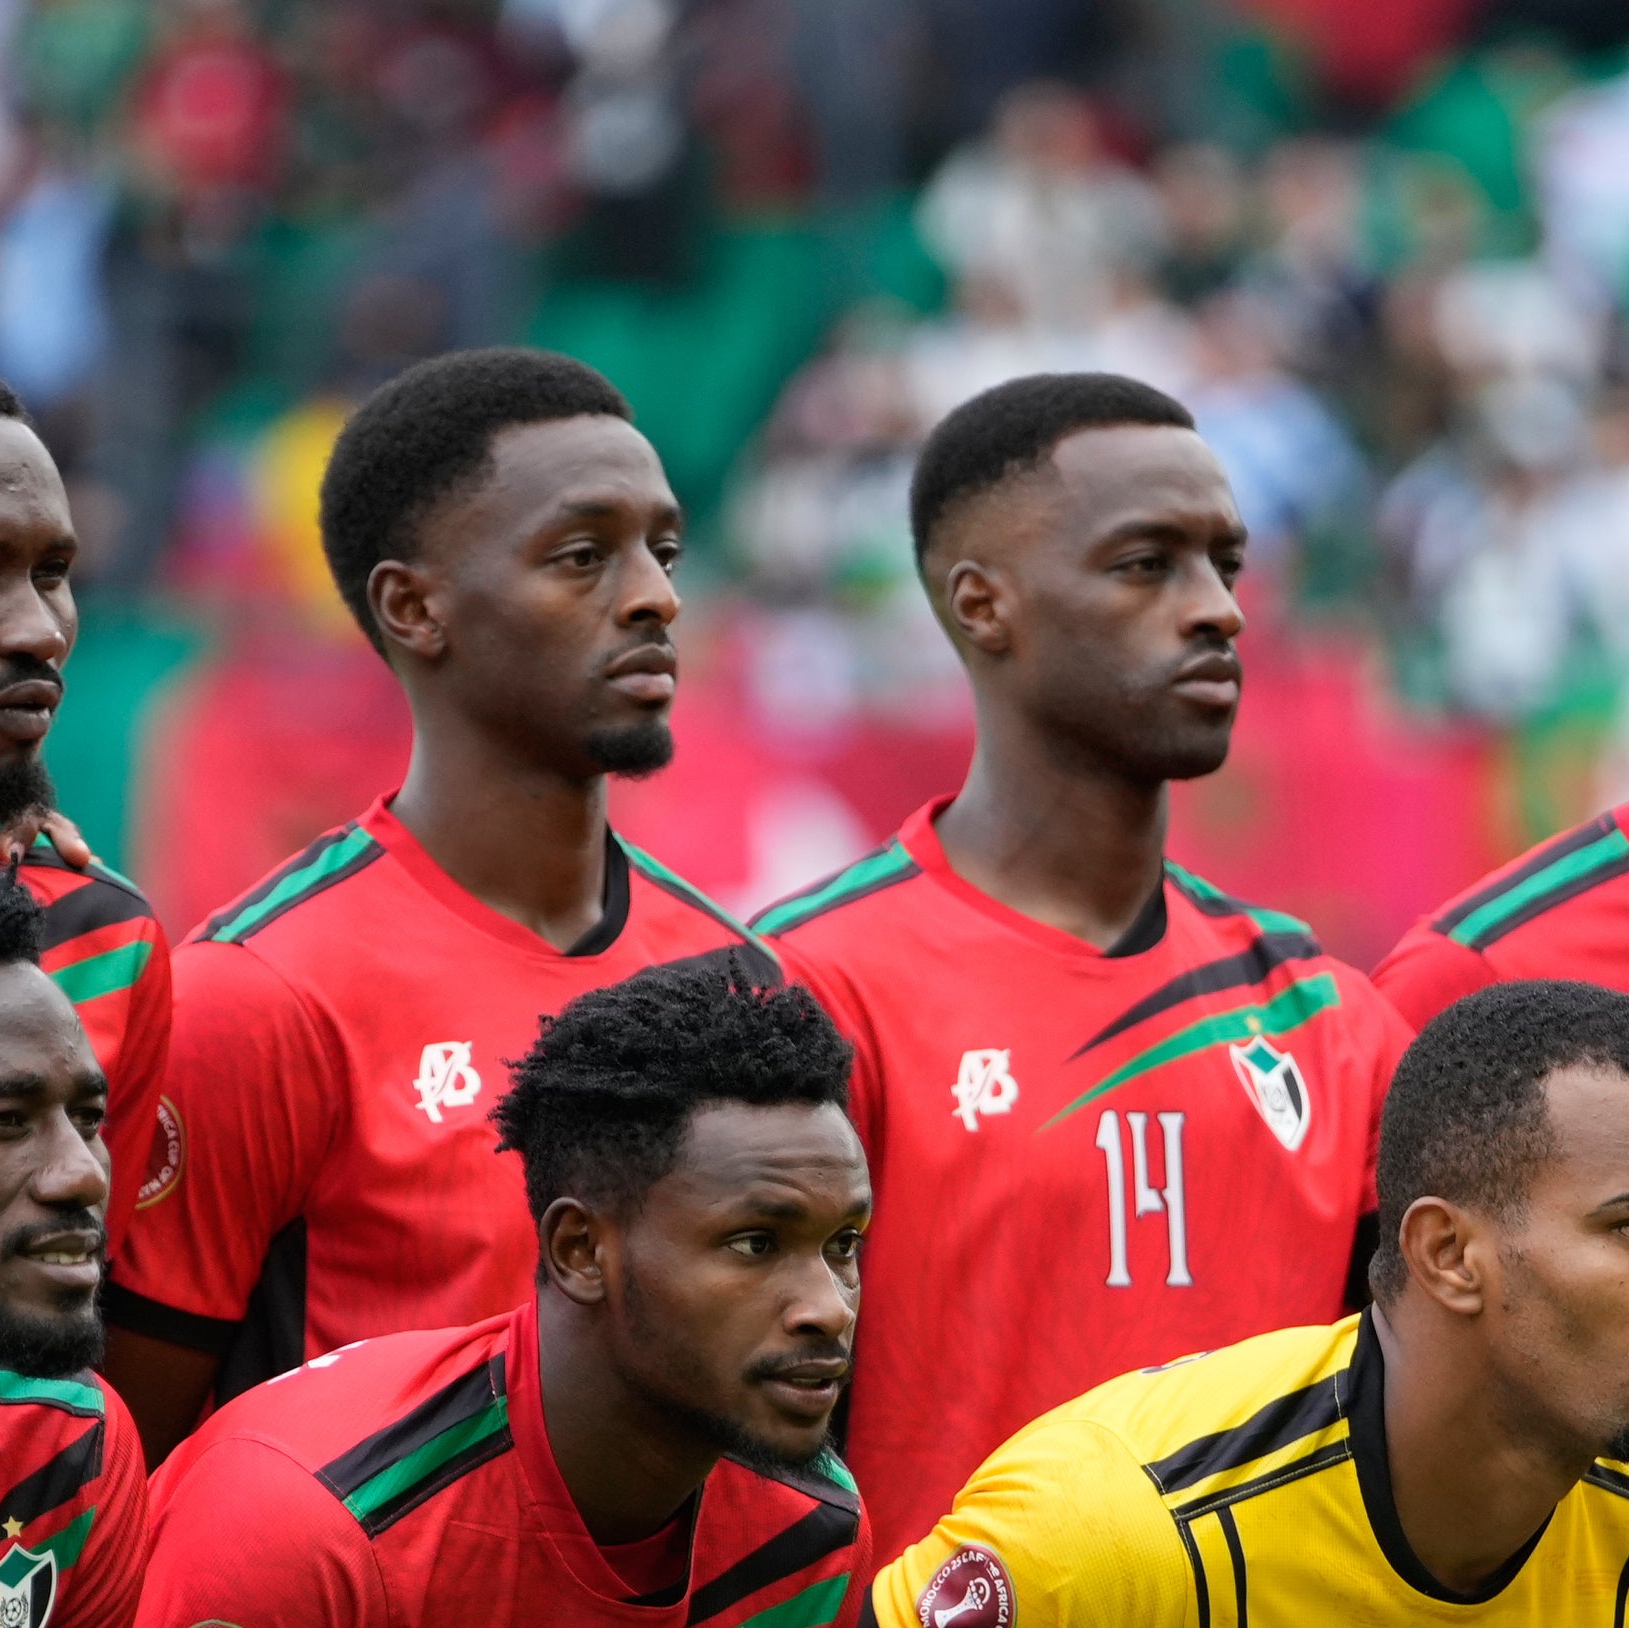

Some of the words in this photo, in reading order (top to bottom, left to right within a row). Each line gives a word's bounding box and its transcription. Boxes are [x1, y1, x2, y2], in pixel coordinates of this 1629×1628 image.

[1095, 1109, 1193, 1288] 14
[962, 1551, 984, 1564] CAF
[920, 1566, 951, 1628] MOROCCO
[951, 1557, 962, 1570] 25
[994, 1579, 1008, 1623] AFRICA
